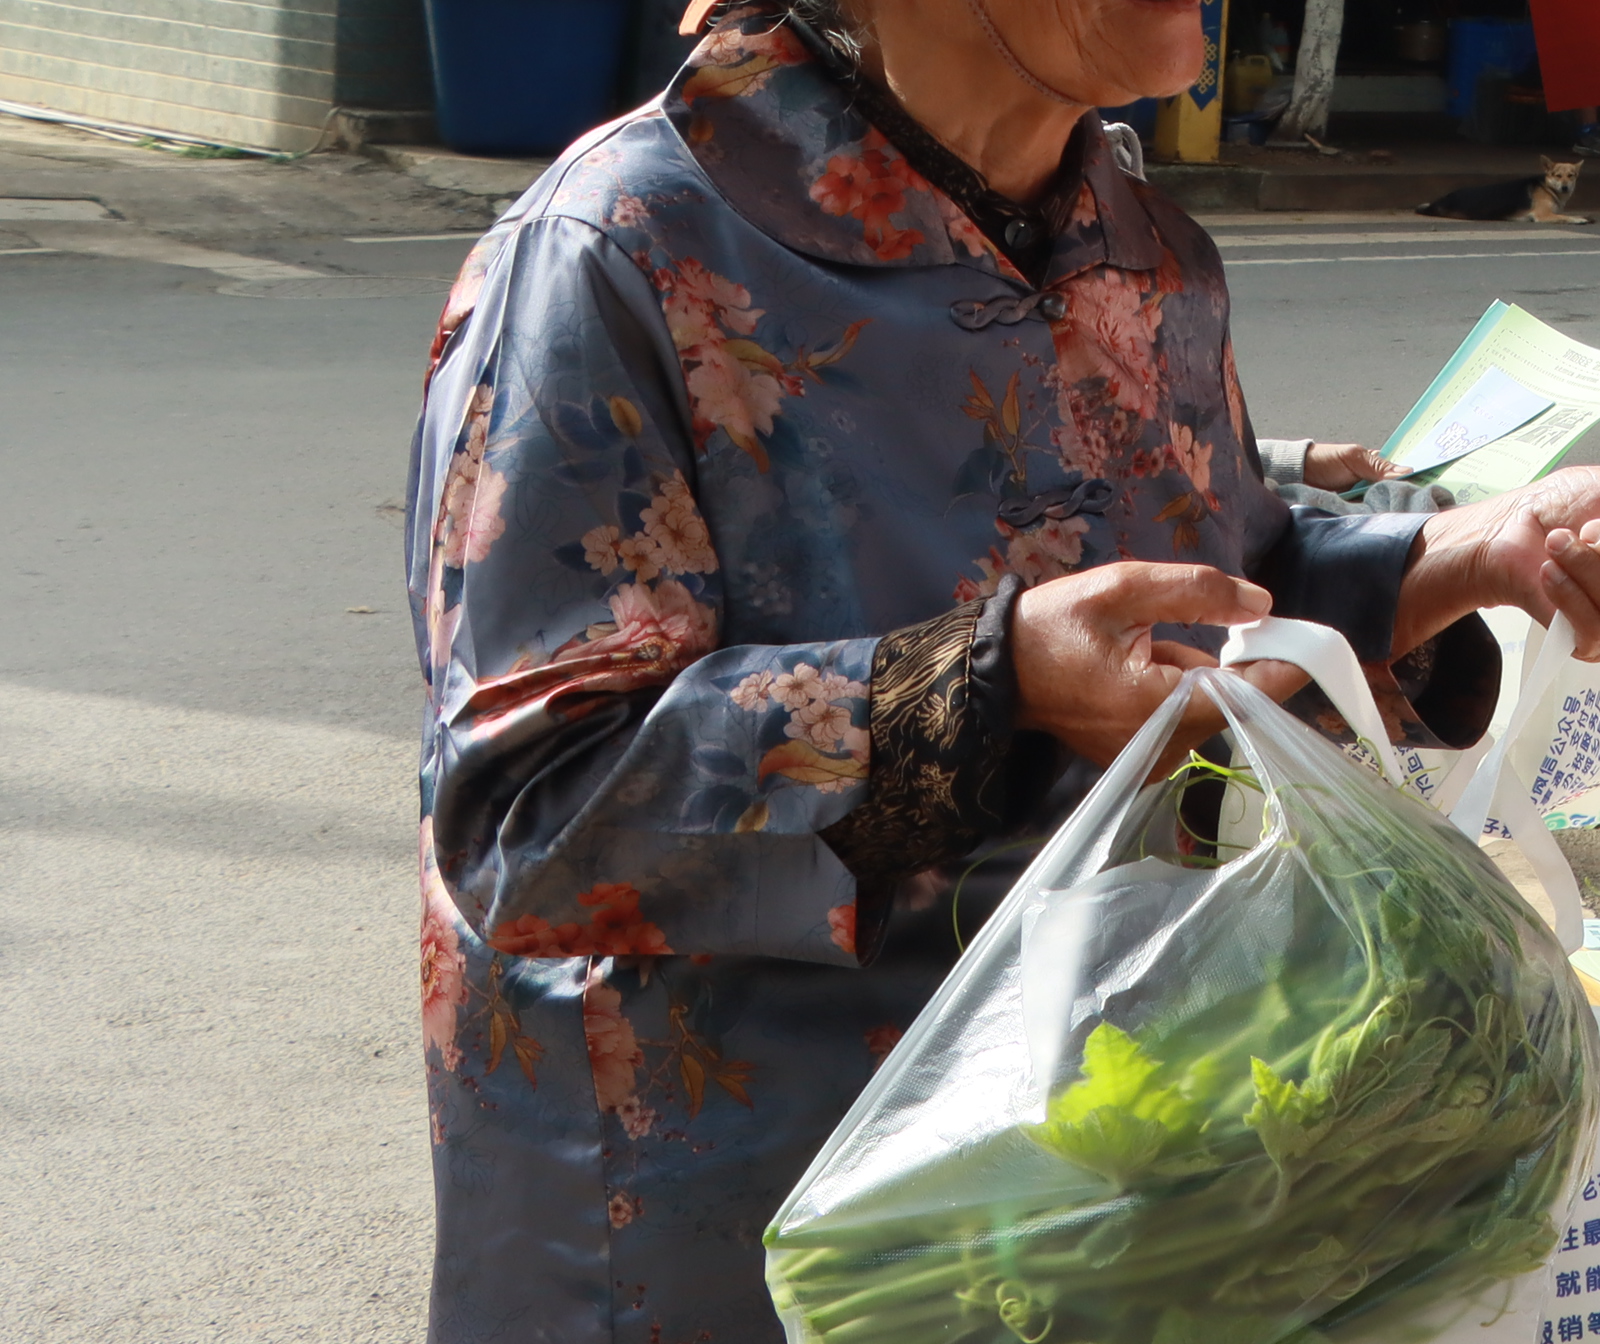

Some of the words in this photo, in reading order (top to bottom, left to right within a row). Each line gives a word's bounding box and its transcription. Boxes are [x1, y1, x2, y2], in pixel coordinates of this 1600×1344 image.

[1531, 689, 1586, 806] 微信公众号、
